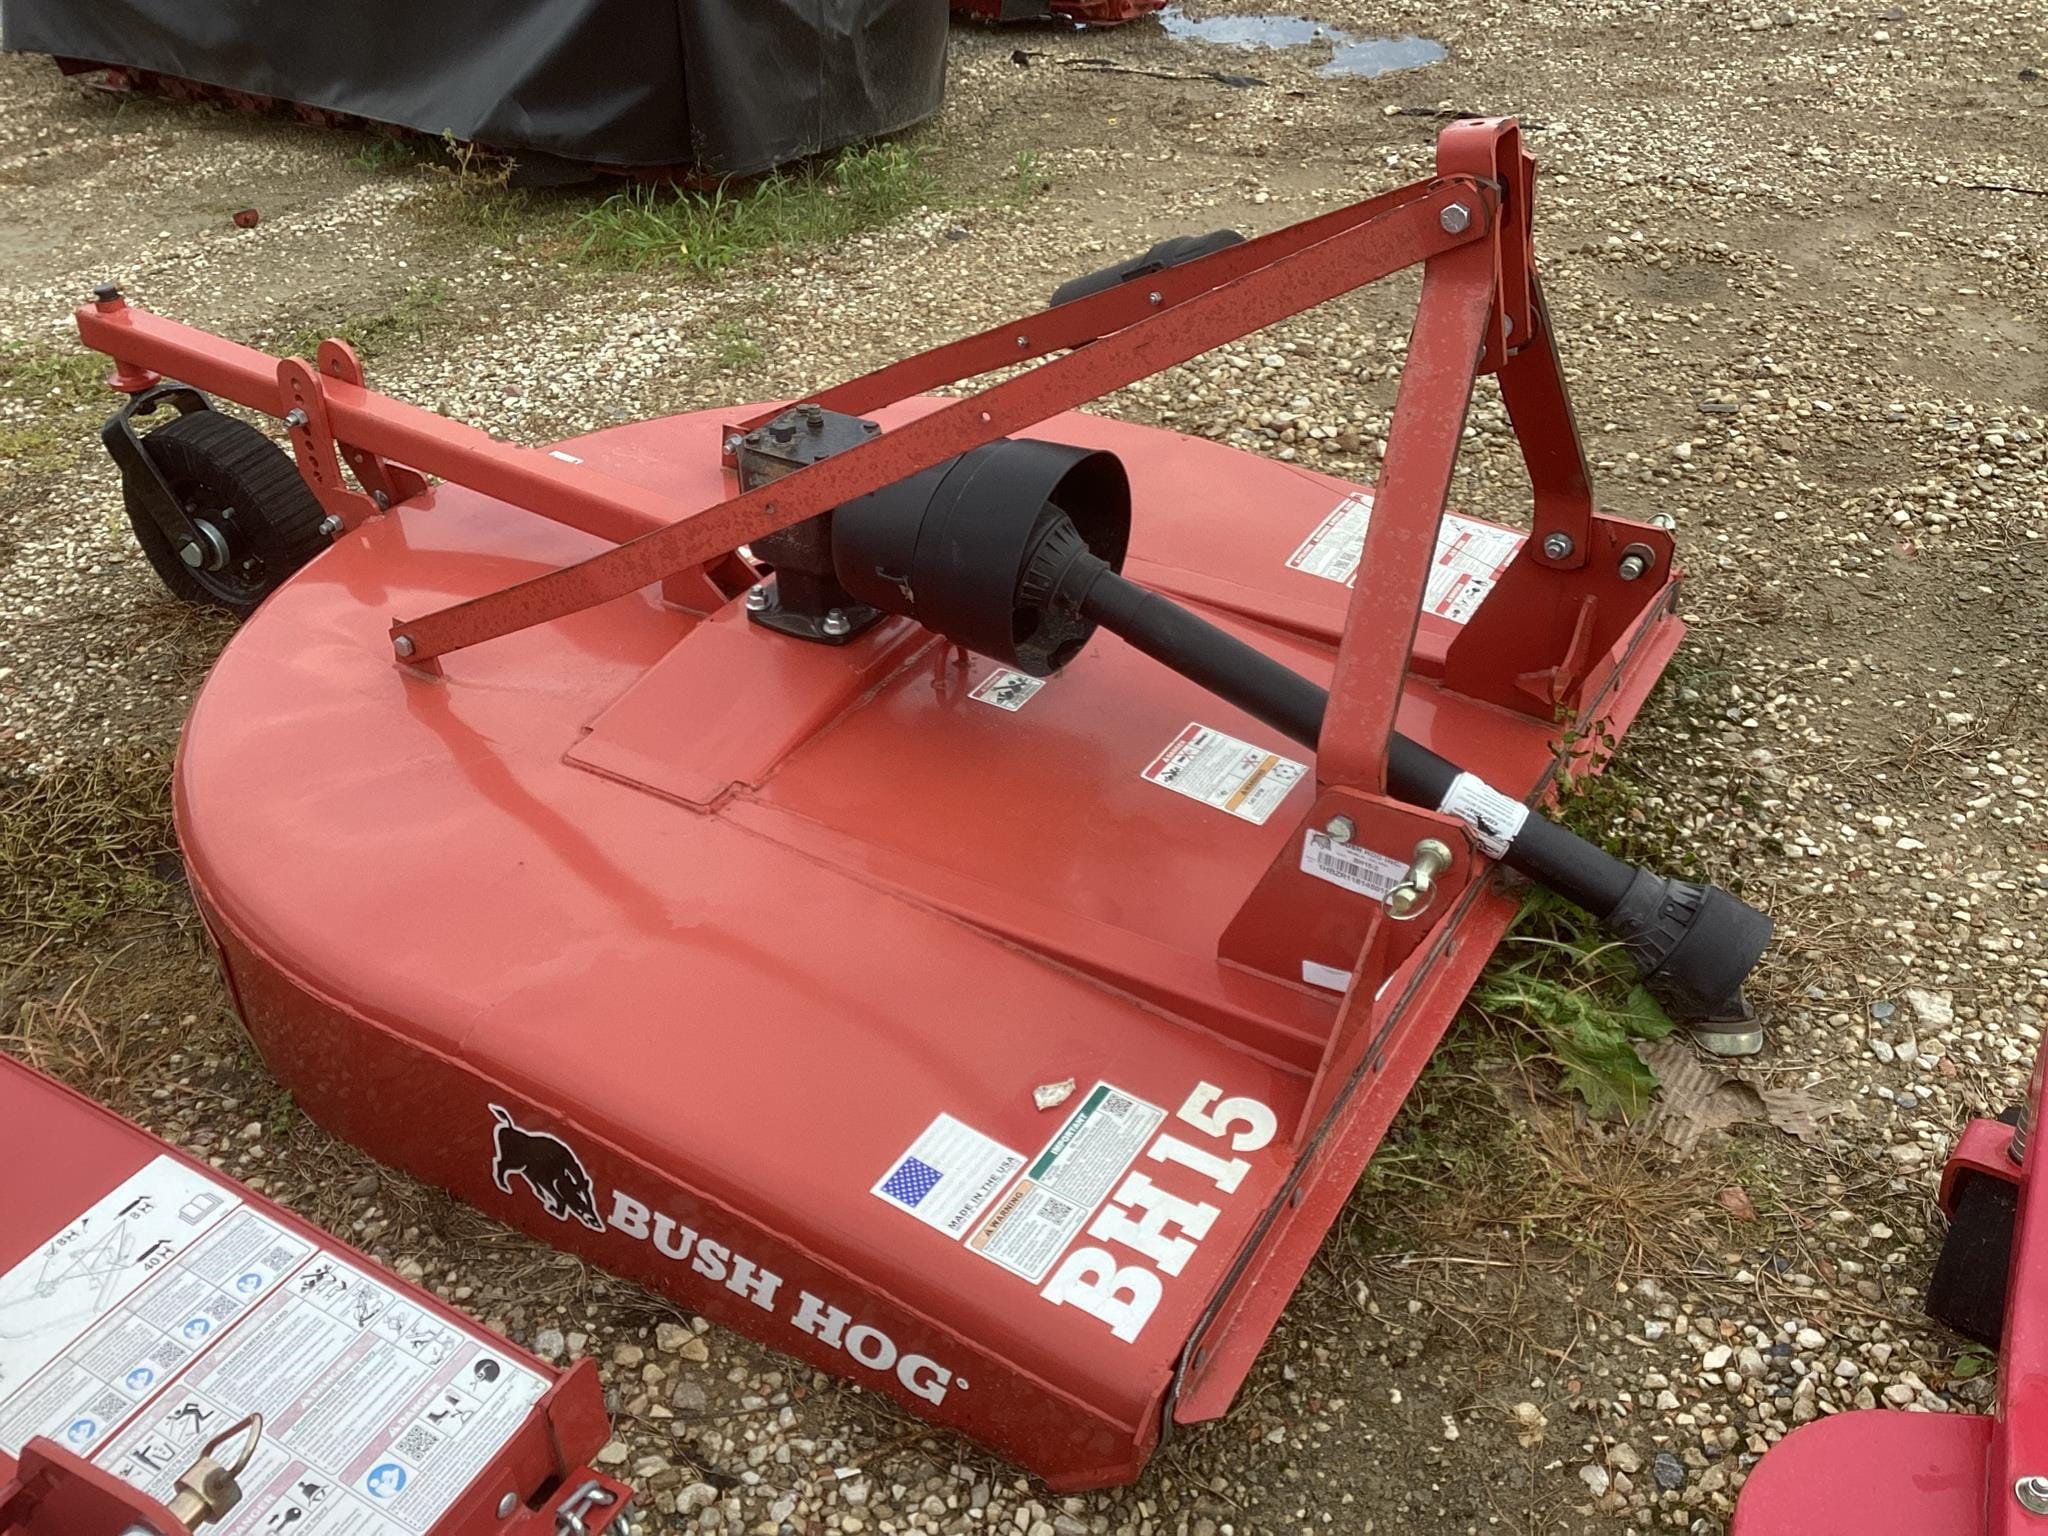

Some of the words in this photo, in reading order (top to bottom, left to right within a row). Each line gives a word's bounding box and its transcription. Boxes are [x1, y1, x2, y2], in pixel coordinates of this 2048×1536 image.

[1050, 1112, 1088, 1155] IMPORTANT
[948, 1203, 973, 1229] MADE
[970, 1191, 983, 1204] IN
[981, 1173, 998, 1192] THE
[996, 1156, 1015, 1173] USA
[990, 1191, 1023, 1228] WARNING
[1040, 1081, 1278, 1344] BH15
[143, 1258, 160, 1272] 40
[607, 1189, 783, 1312] BUSH
[790, 1290, 953, 1406] HOG
[398, 1382, 441, 1428] DANGER
